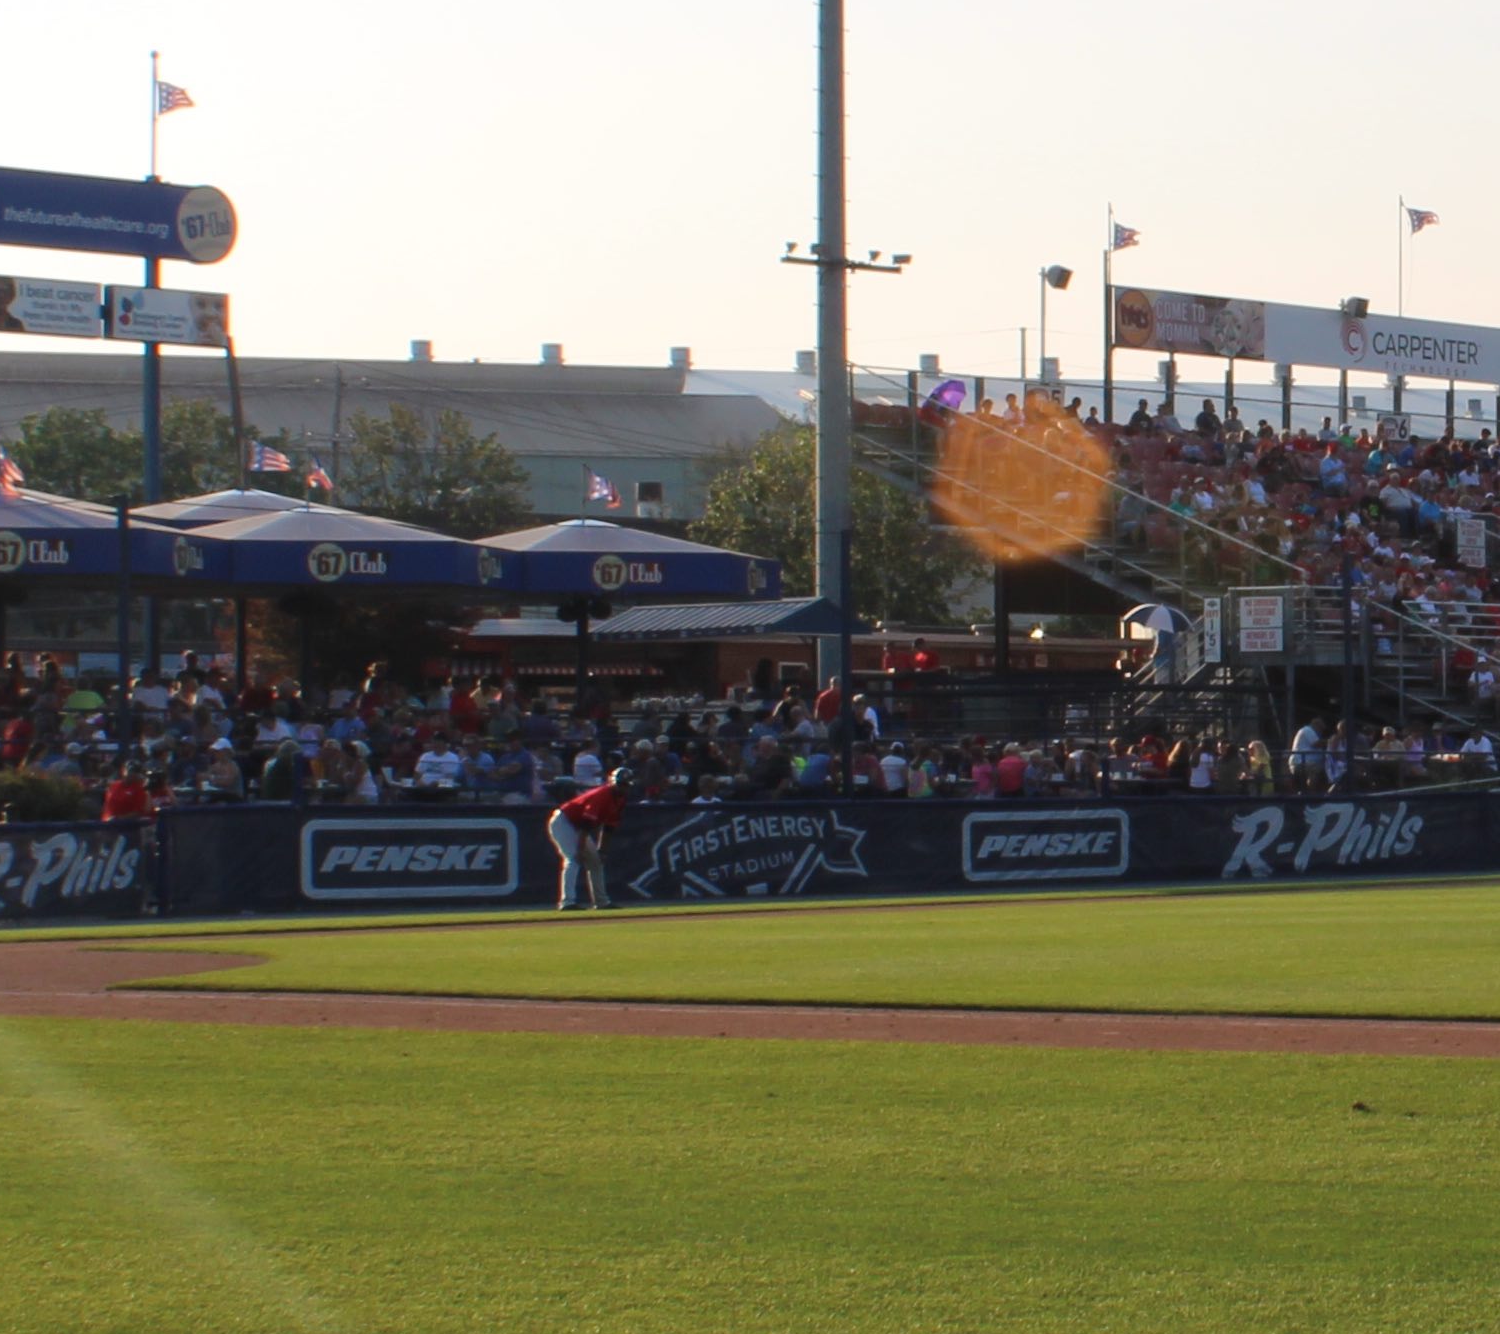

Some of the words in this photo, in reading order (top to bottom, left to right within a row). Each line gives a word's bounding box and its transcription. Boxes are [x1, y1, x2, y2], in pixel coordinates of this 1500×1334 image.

[1156, 299, 1188, 321] COME
[1192, 303, 1206, 323] TO
[1372, 331, 1479, 365] CARPENTER
[28, 539, 69, 564] Club
[310, 552, 343, 578] '67
[349, 550, 387, 575] Club
[629, 563, 663, 584] Club
[976, 830, 1116, 861] PENSKE
[1222, 801, 1424, 879] R-Phils
[320, 843, 503, 874] PENSKE
[708, 850, 794, 883] STADIUM
